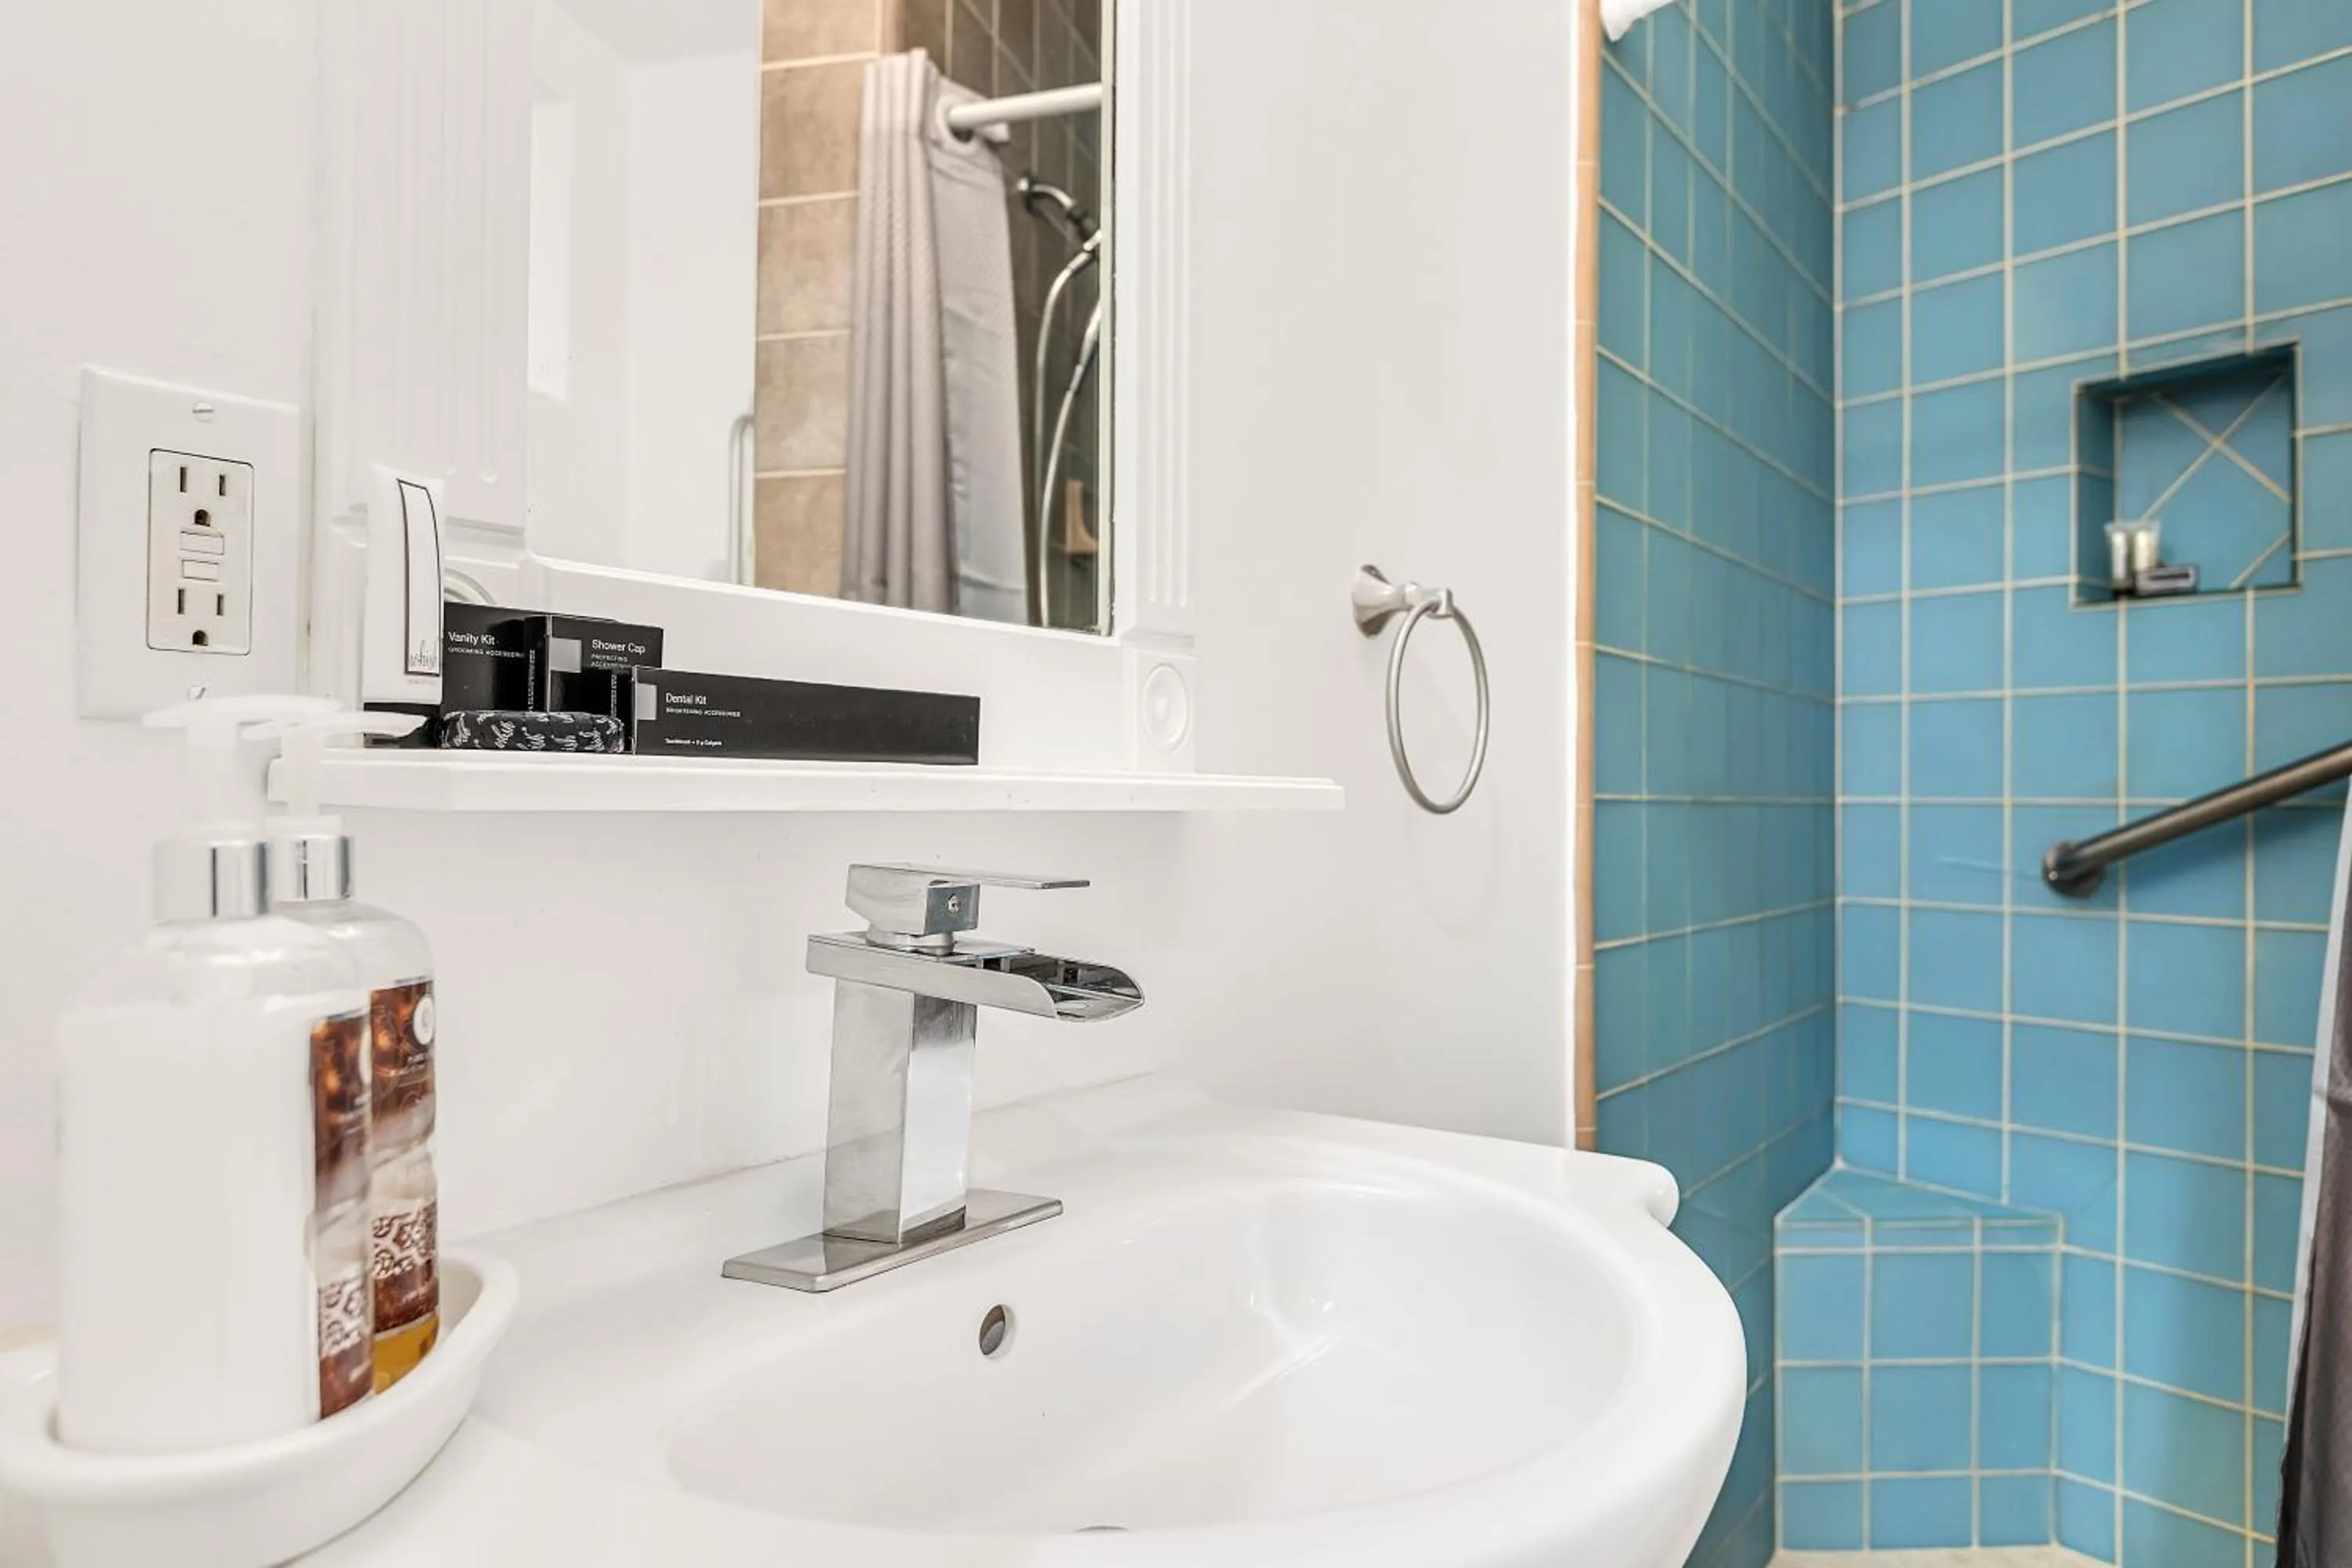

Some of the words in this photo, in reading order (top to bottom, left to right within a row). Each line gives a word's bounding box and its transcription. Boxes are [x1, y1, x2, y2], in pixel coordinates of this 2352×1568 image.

[448, 631, 479, 645] Vanity
[481, 634, 495, 645] Kit
[592, 639, 626, 652] Shower
[628, 642, 646, 655] Cap
[666, 692, 693, 704] Dental
[695, 695, 706, 705] Kit
